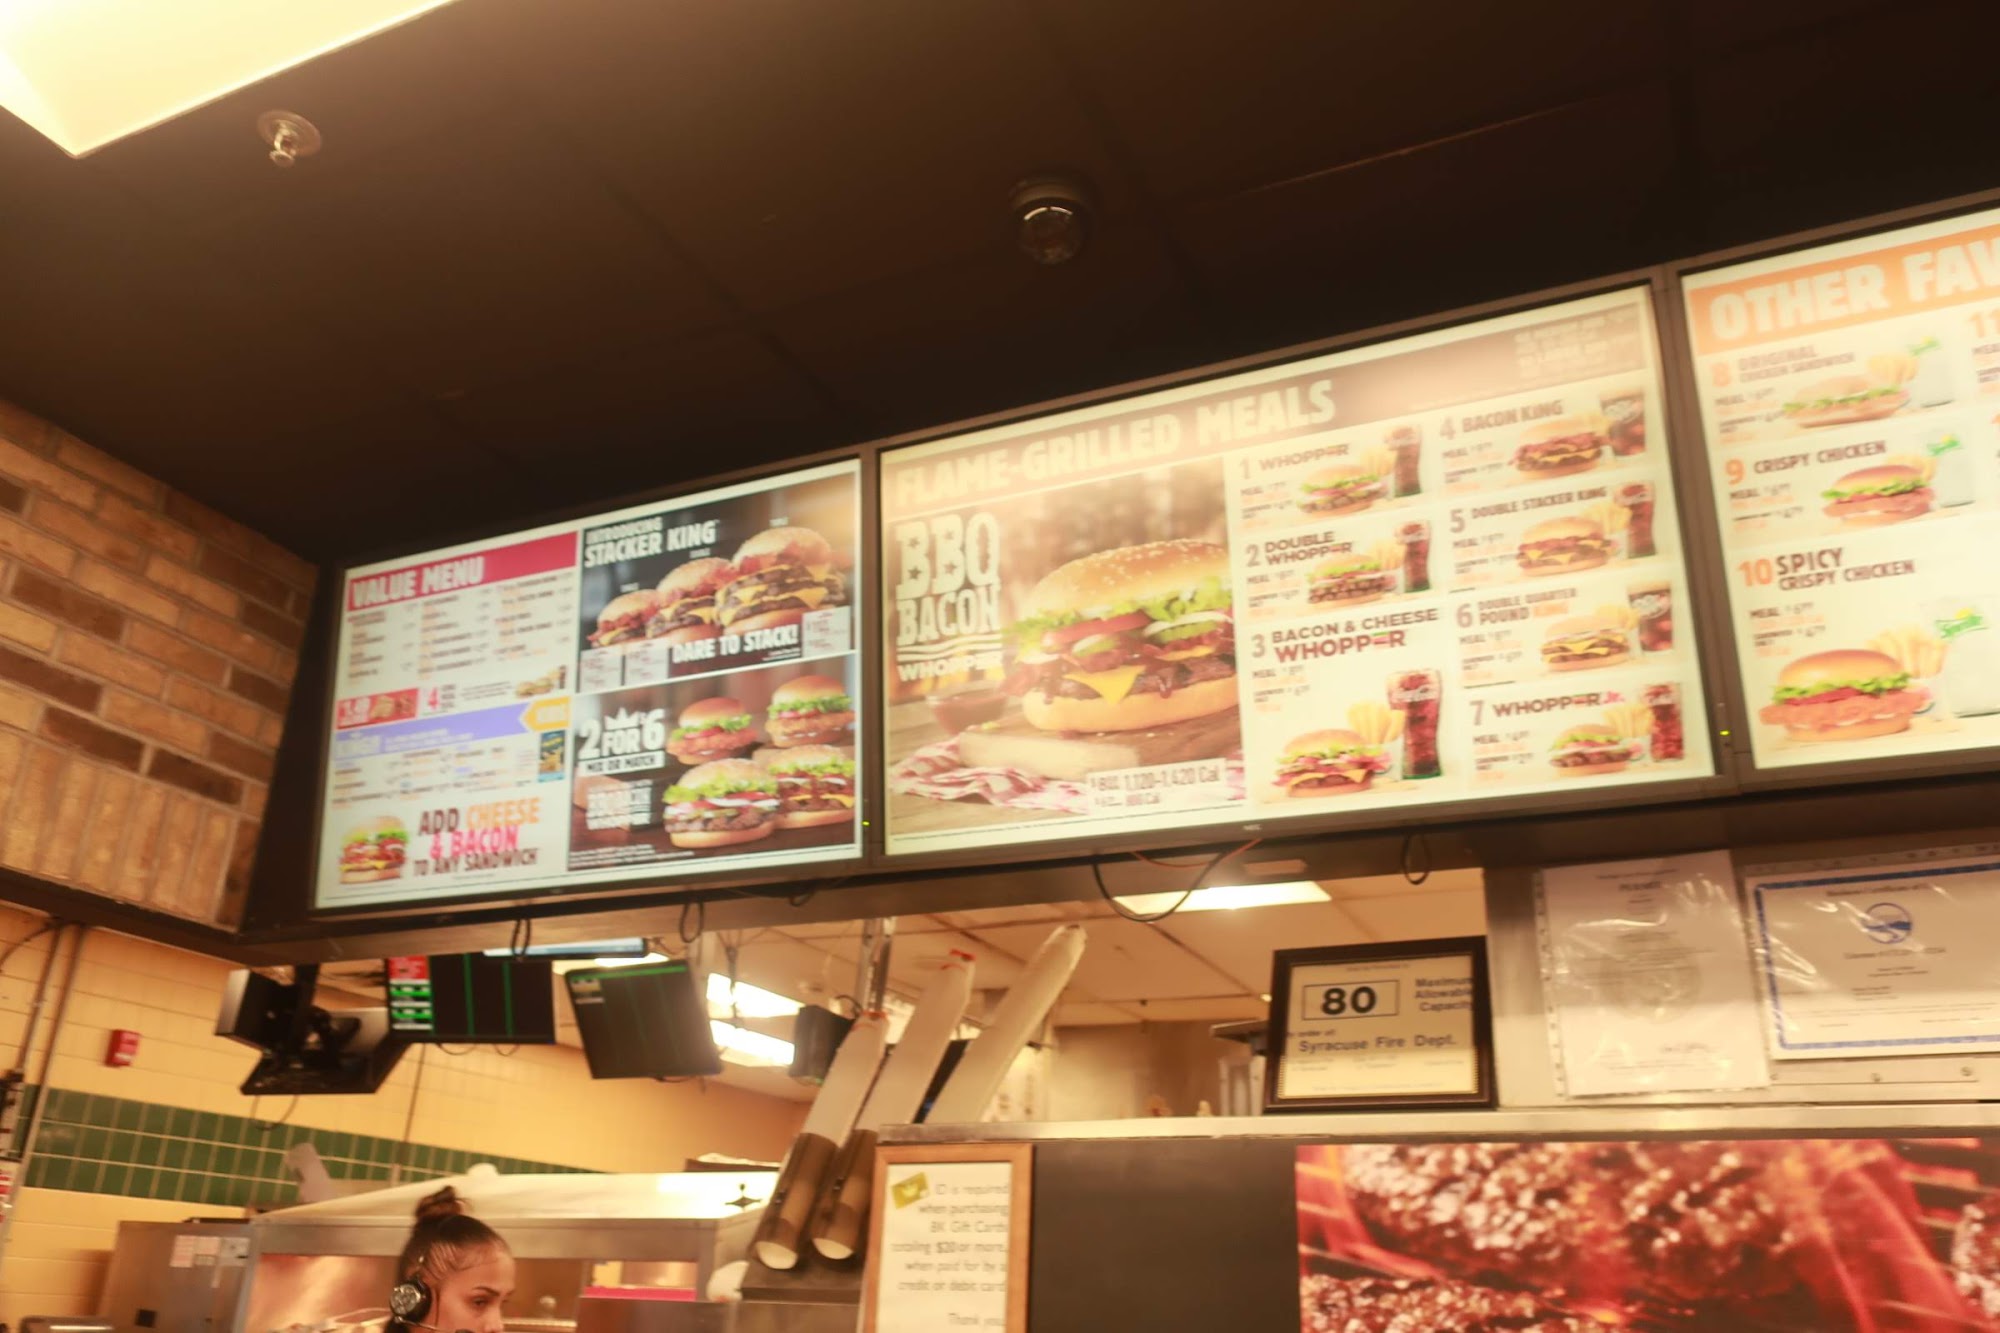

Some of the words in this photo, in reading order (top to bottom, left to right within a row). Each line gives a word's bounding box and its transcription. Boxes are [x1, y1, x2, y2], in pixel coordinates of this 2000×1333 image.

[1709, 264, 1890, 340] OTHER
[1441, 417, 1455, 440] 4
[1462, 410, 1518, 433] BACON
[1521, 400, 1563, 420] KING
[896, 412, 1182, 508] FLAME-GRILLED
[1198, 379, 1336, 447] MEALS
[1240, 457, 1250, 480] 1
[1725, 458, 1745, 485] 9
[1754, 453, 1810, 474] CRISPY
[1817, 441, 1886, 463] CHICKEN
[1450, 508, 1465, 533] 5
[1471, 502, 1518, 519] DOUBLE
[1523, 492, 1573, 511] STACKER
[584, 531, 662, 567] STACKER
[667, 520, 716, 552] KING
[896, 512, 1001, 600] BBQ
[1246, 544, 1260, 567] 2
[1265, 531, 1335, 553] DOUBLE
[1739, 558, 1772, 587] 10
[1776, 548, 1843, 576] SPICY
[1778, 571, 1836, 591] CRISPY
[1843, 560, 1915, 582] CHICKEN
[353, 569, 417, 609] VALUE
[421, 555, 486, 595] MENU
[896, 584, 1001, 646] BACON
[1272, 623, 1339, 644] BACON
[1345, 620, 1355, 633] &
[1362, 608, 1439, 630] CHEESE
[1456, 603, 1472, 628] 6
[1480, 606, 1530, 626] POUND
[672, 638, 715, 664] DARE
[719, 634, 741, 656] TO
[744, 624, 799, 651] STACK!
[1252, 633, 1265, 658] 3
[1470, 700, 1484, 727] 7
[578, 719, 601, 760] 2
[602, 728, 641, 757] FOR
[419, 807, 461, 836] ADD
[466, 797, 541, 829] CHEESE
[430, 831, 443, 860] &
[451, 825, 519, 853] BACON
[414, 859, 430, 876] TO
[434, 856, 460, 875] ANY
[465, 848, 538, 872] SANDWICH
[1321, 986, 1377, 1015] 80
[1299, 1040, 1368, 1055] Syracuse
[1375, 1036, 1406, 1049] Fire
[1414, 1034, 1457, 1050] Dept.
